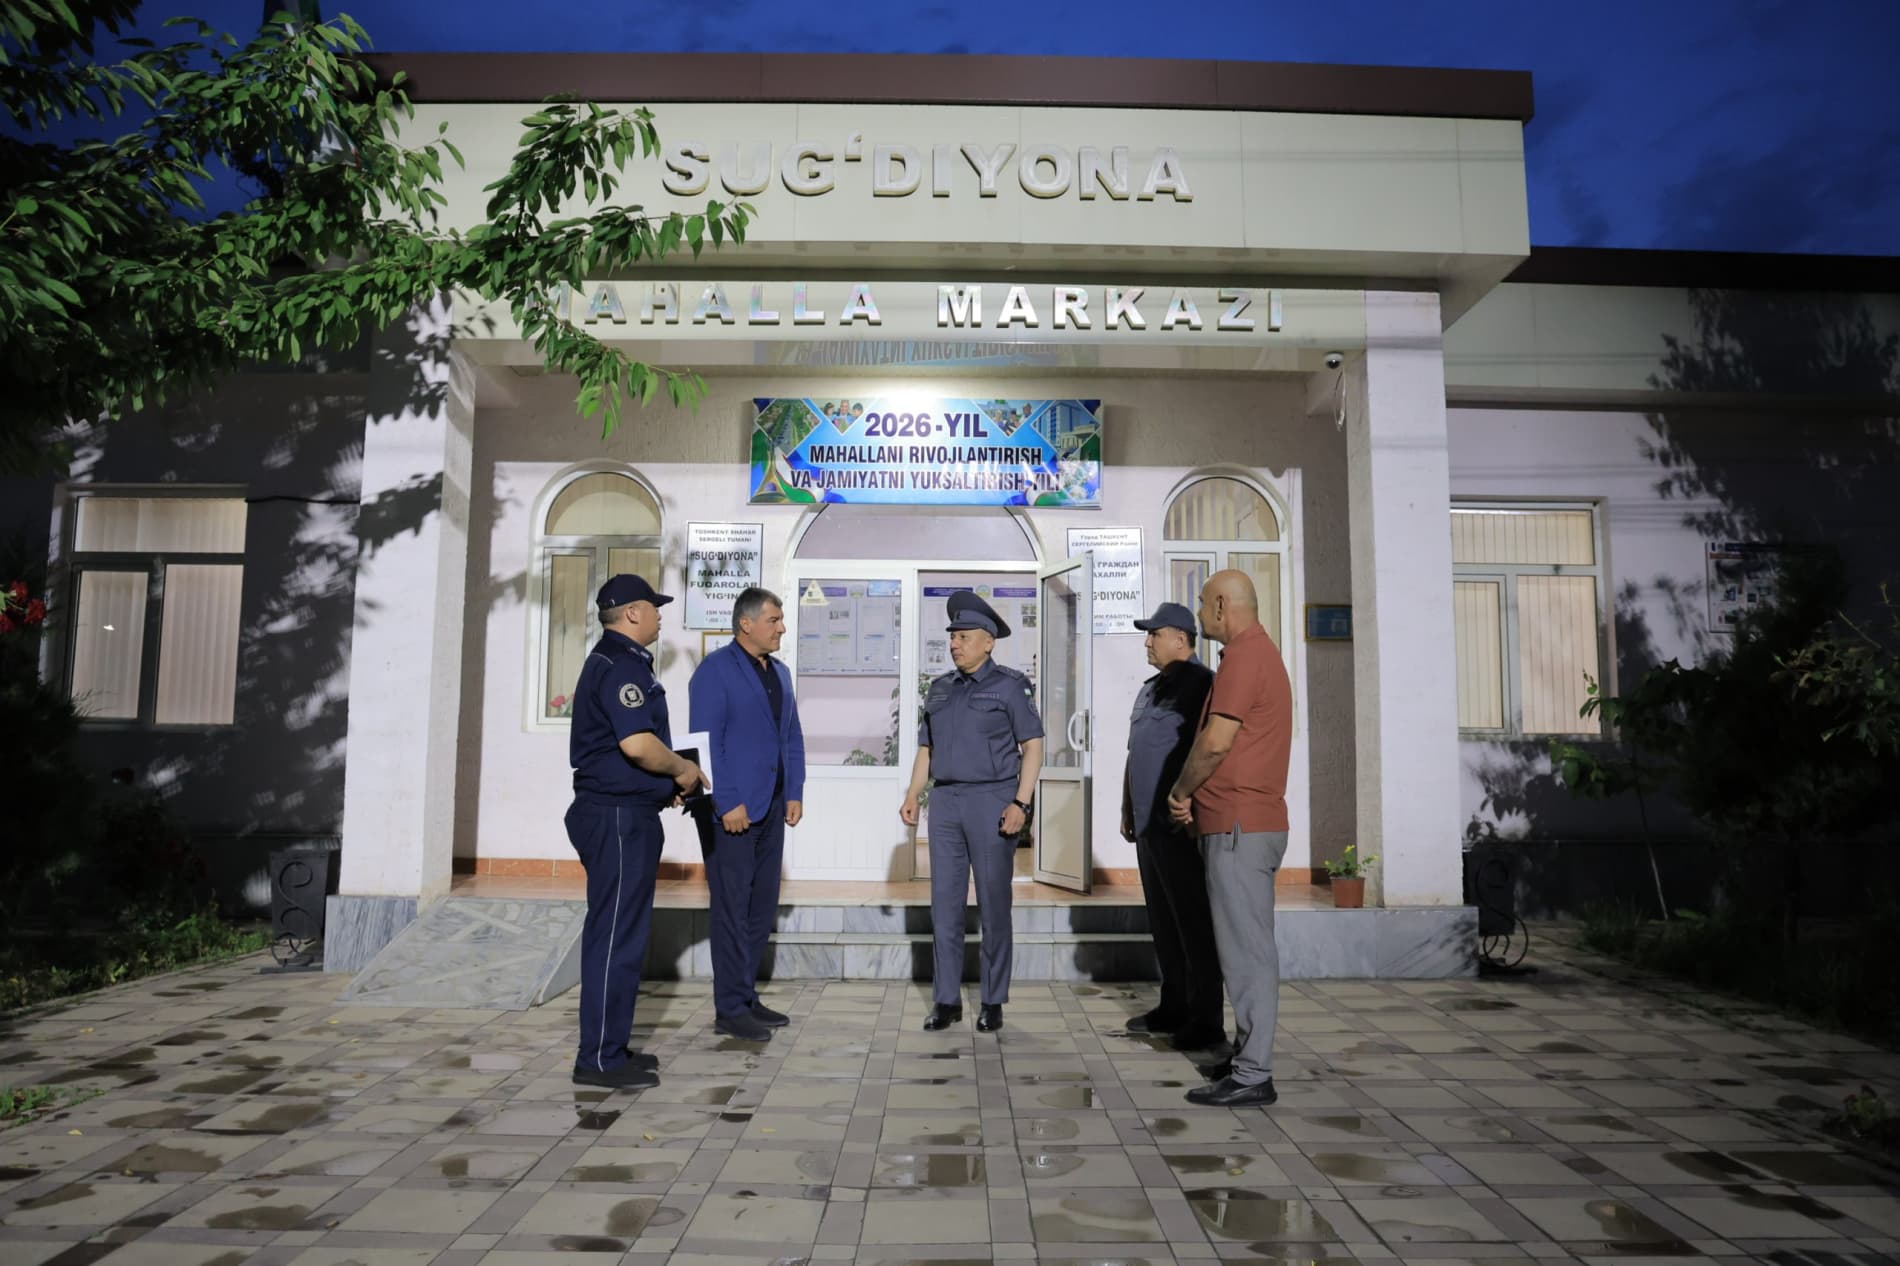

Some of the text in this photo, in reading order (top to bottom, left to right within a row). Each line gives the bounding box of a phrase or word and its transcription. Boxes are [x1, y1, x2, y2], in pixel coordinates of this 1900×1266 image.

[662, 129, 1193, 202] SUG‘DIYONA
[936, 284, 1283, 332] MARKAZI
[864, 412, 989, 439] 2026-YIL
[810, 445, 1042, 466] MAHALLANI RIVOJLANTIRISH
[790, 469, 812, 488] VA
[816, 470, 905, 490] JAMIYATNI
[704, 592, 738, 600] YIG‘IN
